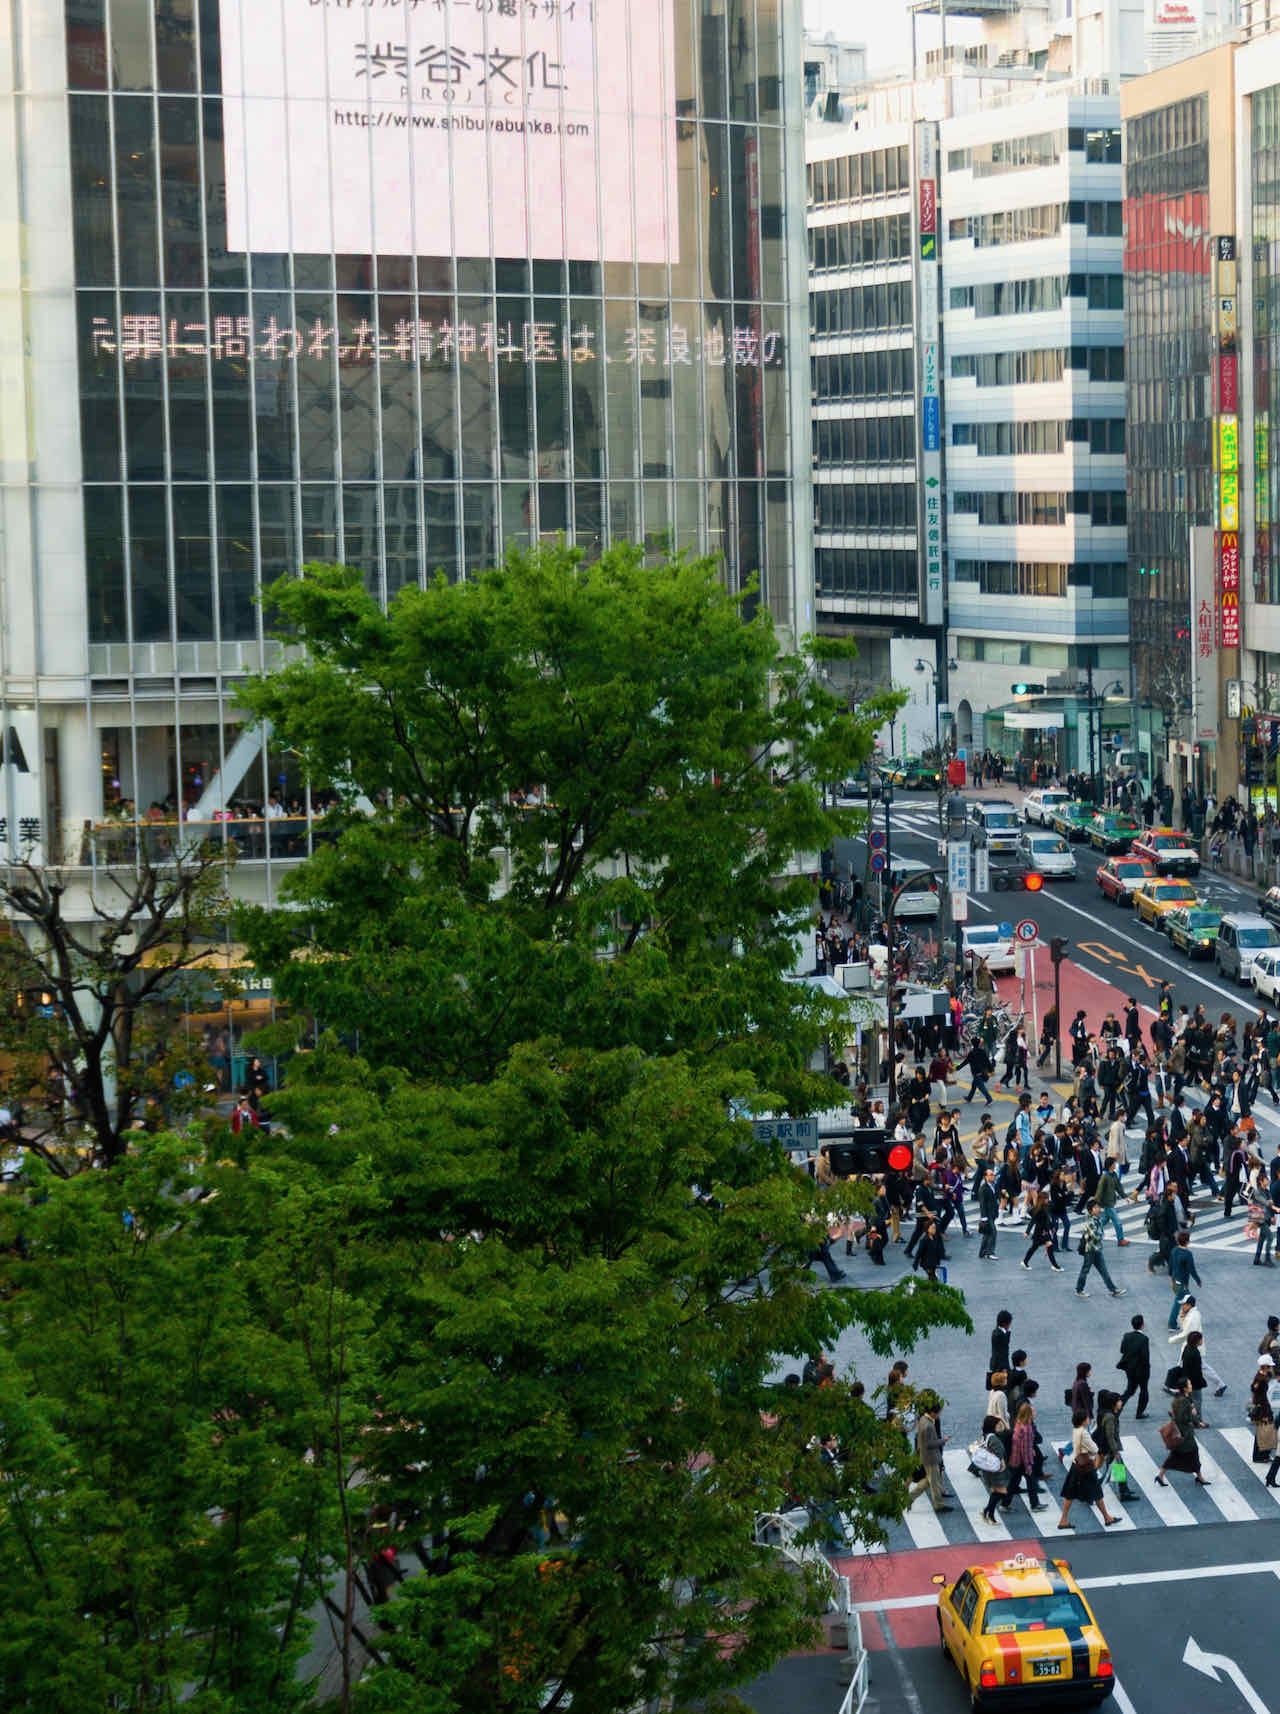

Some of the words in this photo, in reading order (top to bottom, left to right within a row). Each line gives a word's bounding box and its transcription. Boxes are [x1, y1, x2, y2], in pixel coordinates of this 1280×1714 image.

[355, 42, 569, 90] 渋谷文化
[758, 1122, 811, 1140] 谷駅前
